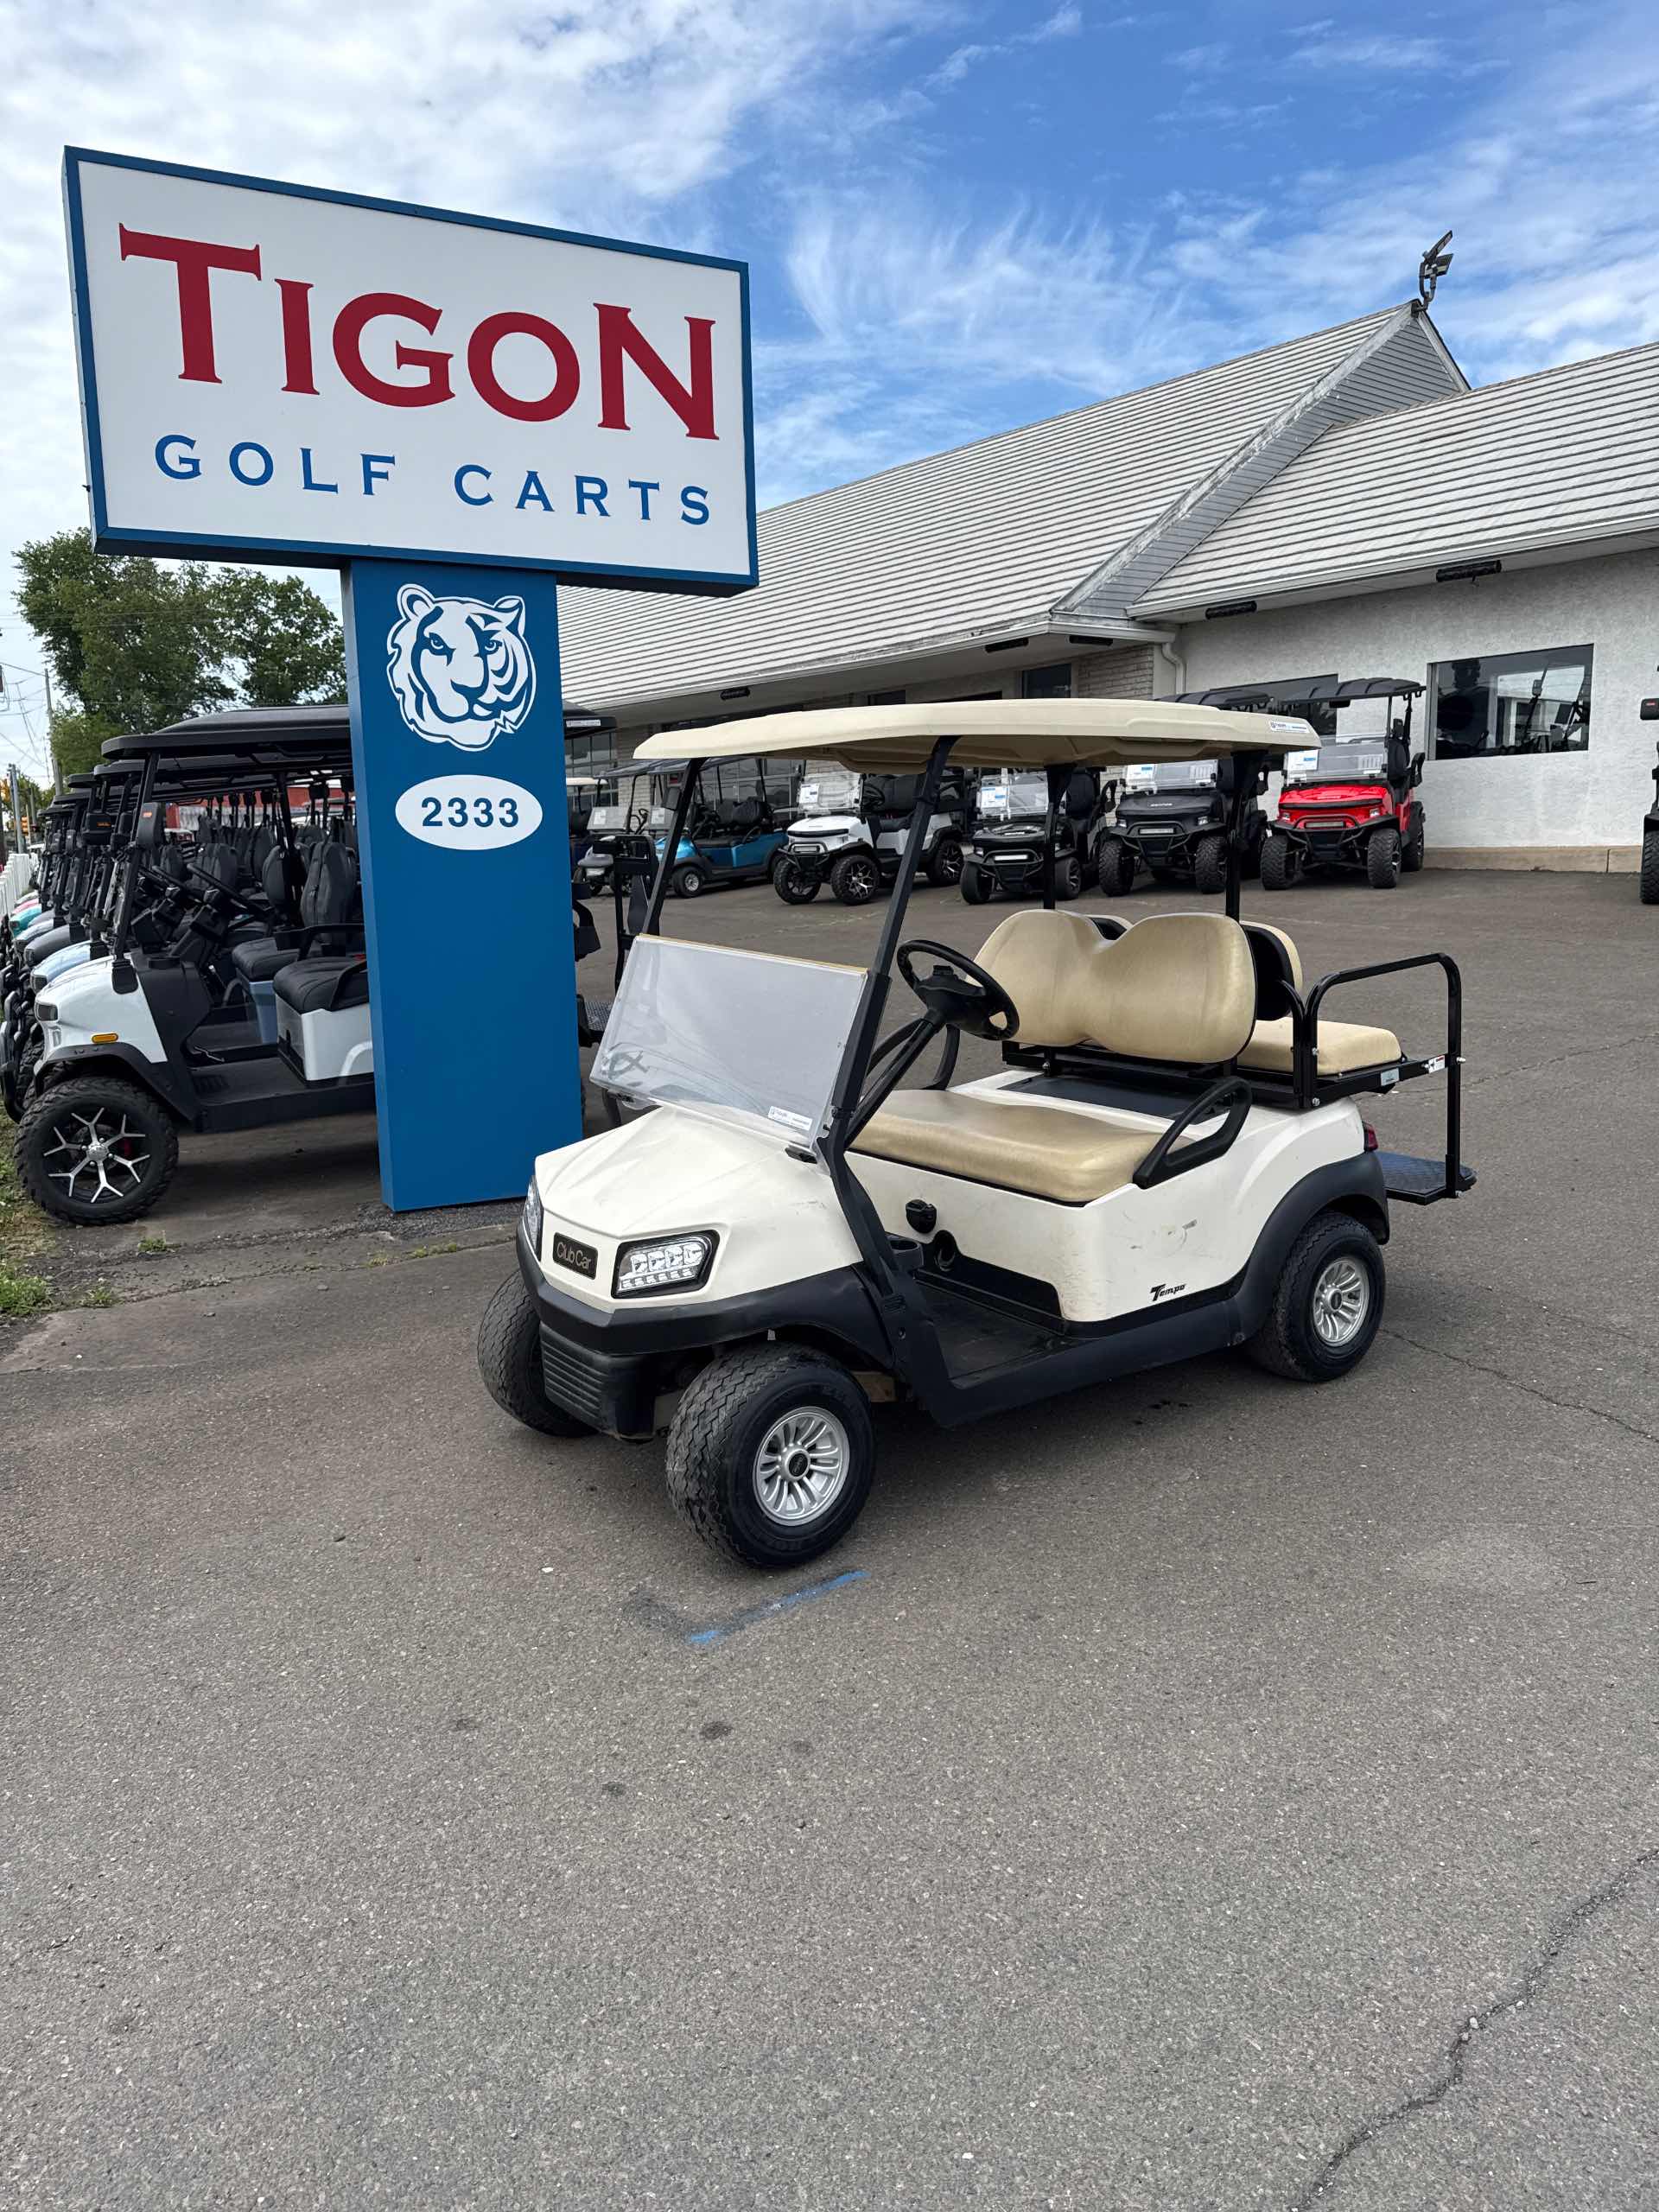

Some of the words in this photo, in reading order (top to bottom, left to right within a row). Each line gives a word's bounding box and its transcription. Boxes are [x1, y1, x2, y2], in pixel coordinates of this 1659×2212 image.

[118, 223, 720, 440] TIGON
[155, 434, 396, 497] GOLF
[454, 463, 711, 526] CARTS
[422, 797, 519, 828] 2333
[1149, 1283, 1186, 1301] Tempo
